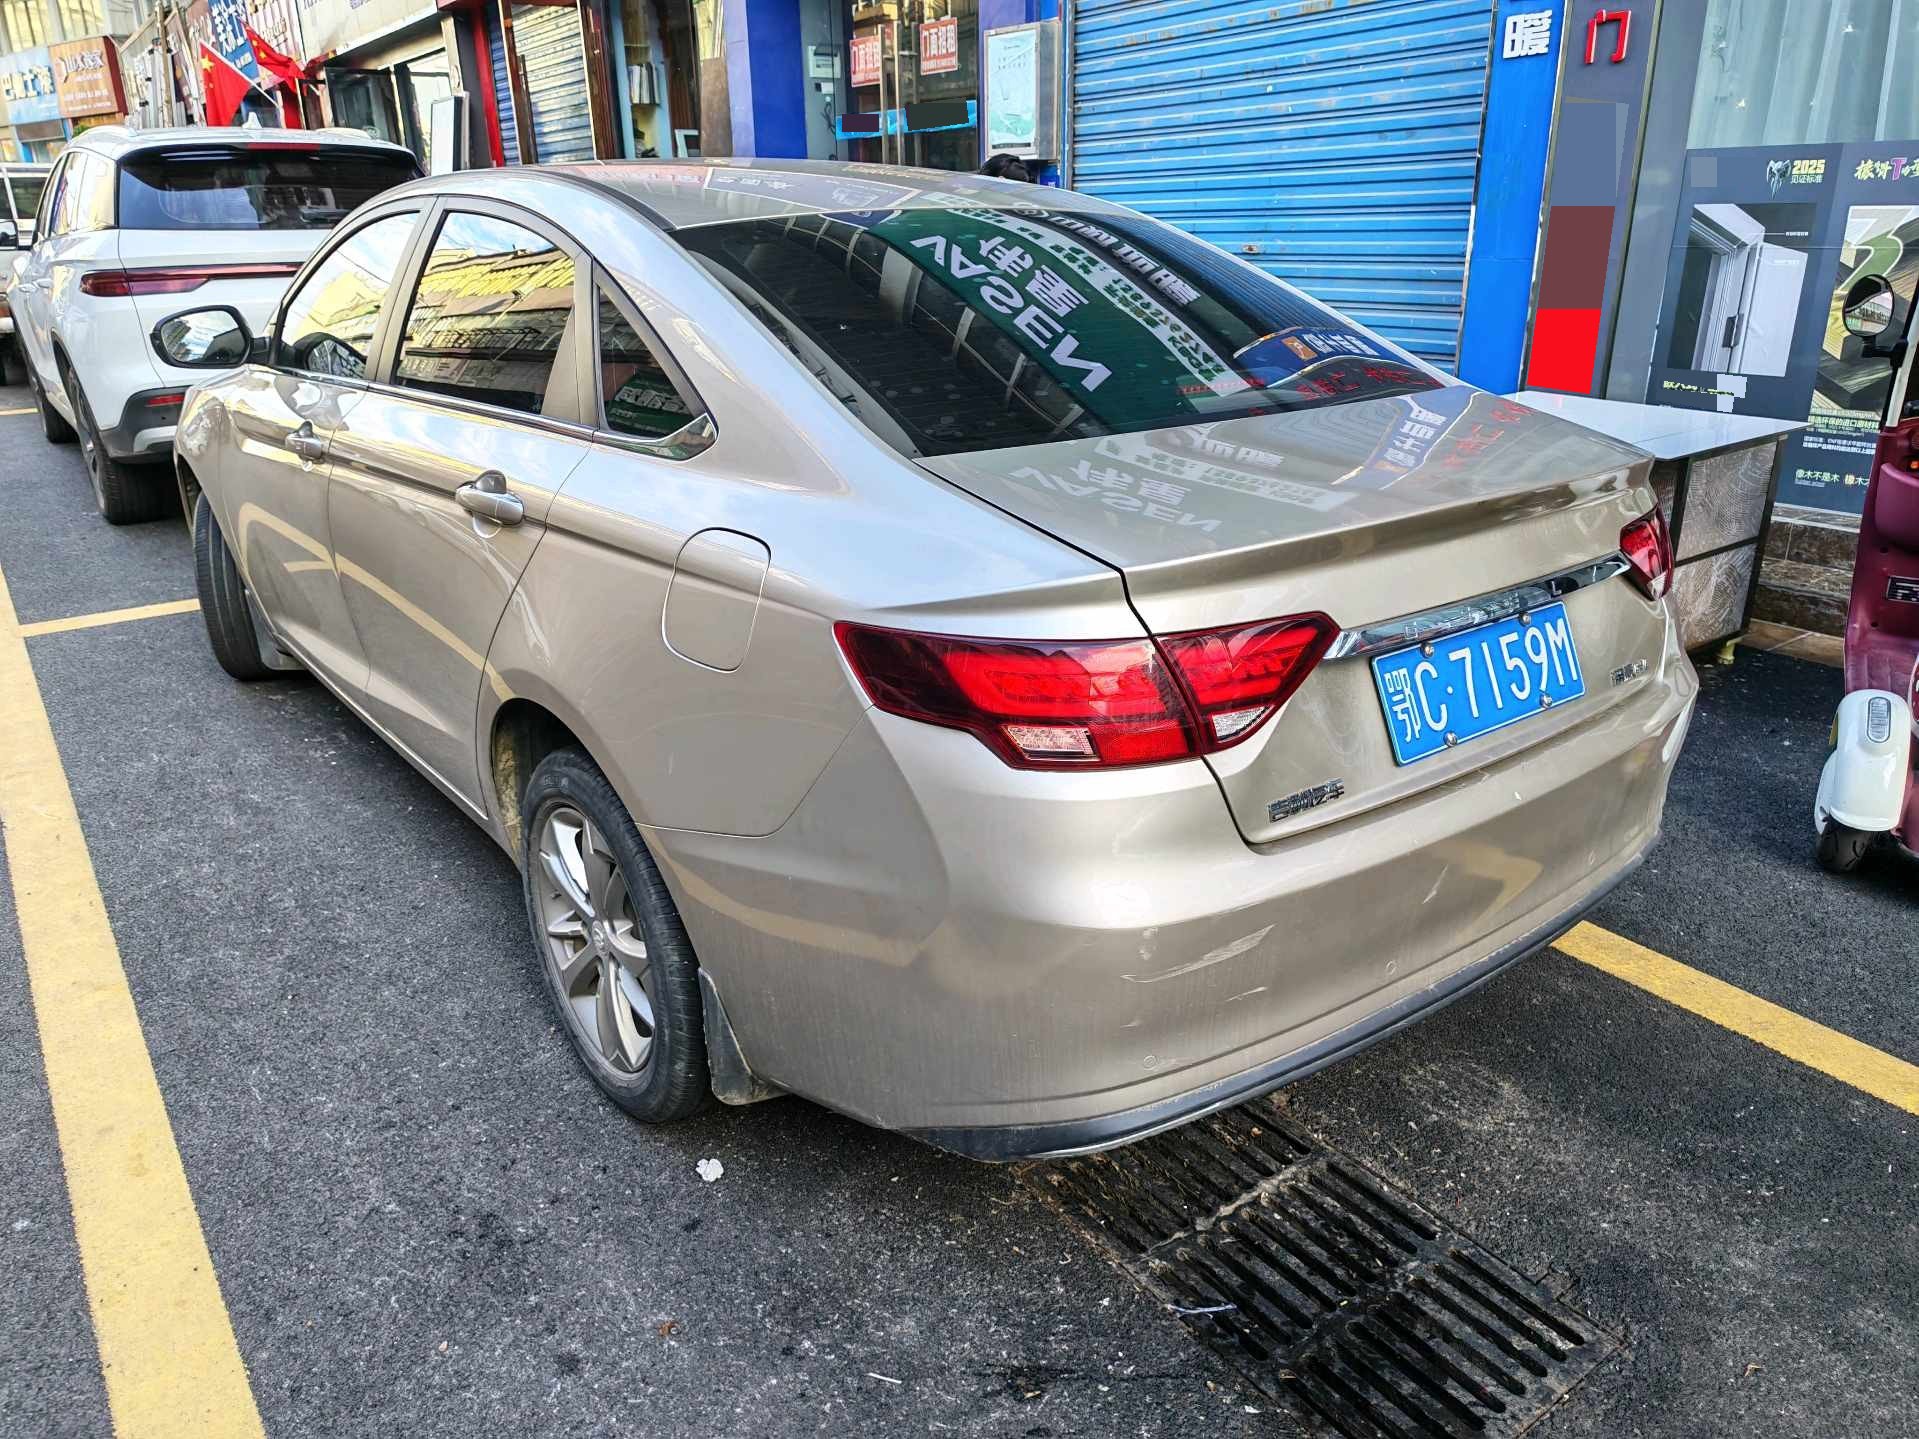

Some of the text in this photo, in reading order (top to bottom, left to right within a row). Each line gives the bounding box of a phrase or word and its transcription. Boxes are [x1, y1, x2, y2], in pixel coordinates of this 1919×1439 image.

[1503, 9, 1552, 59] 暖
[1584, 9, 1631, 64] 门
[1792, 159, 1826, 174] 2025
[1384, 617, 1578, 743] 鄂C·7159M
